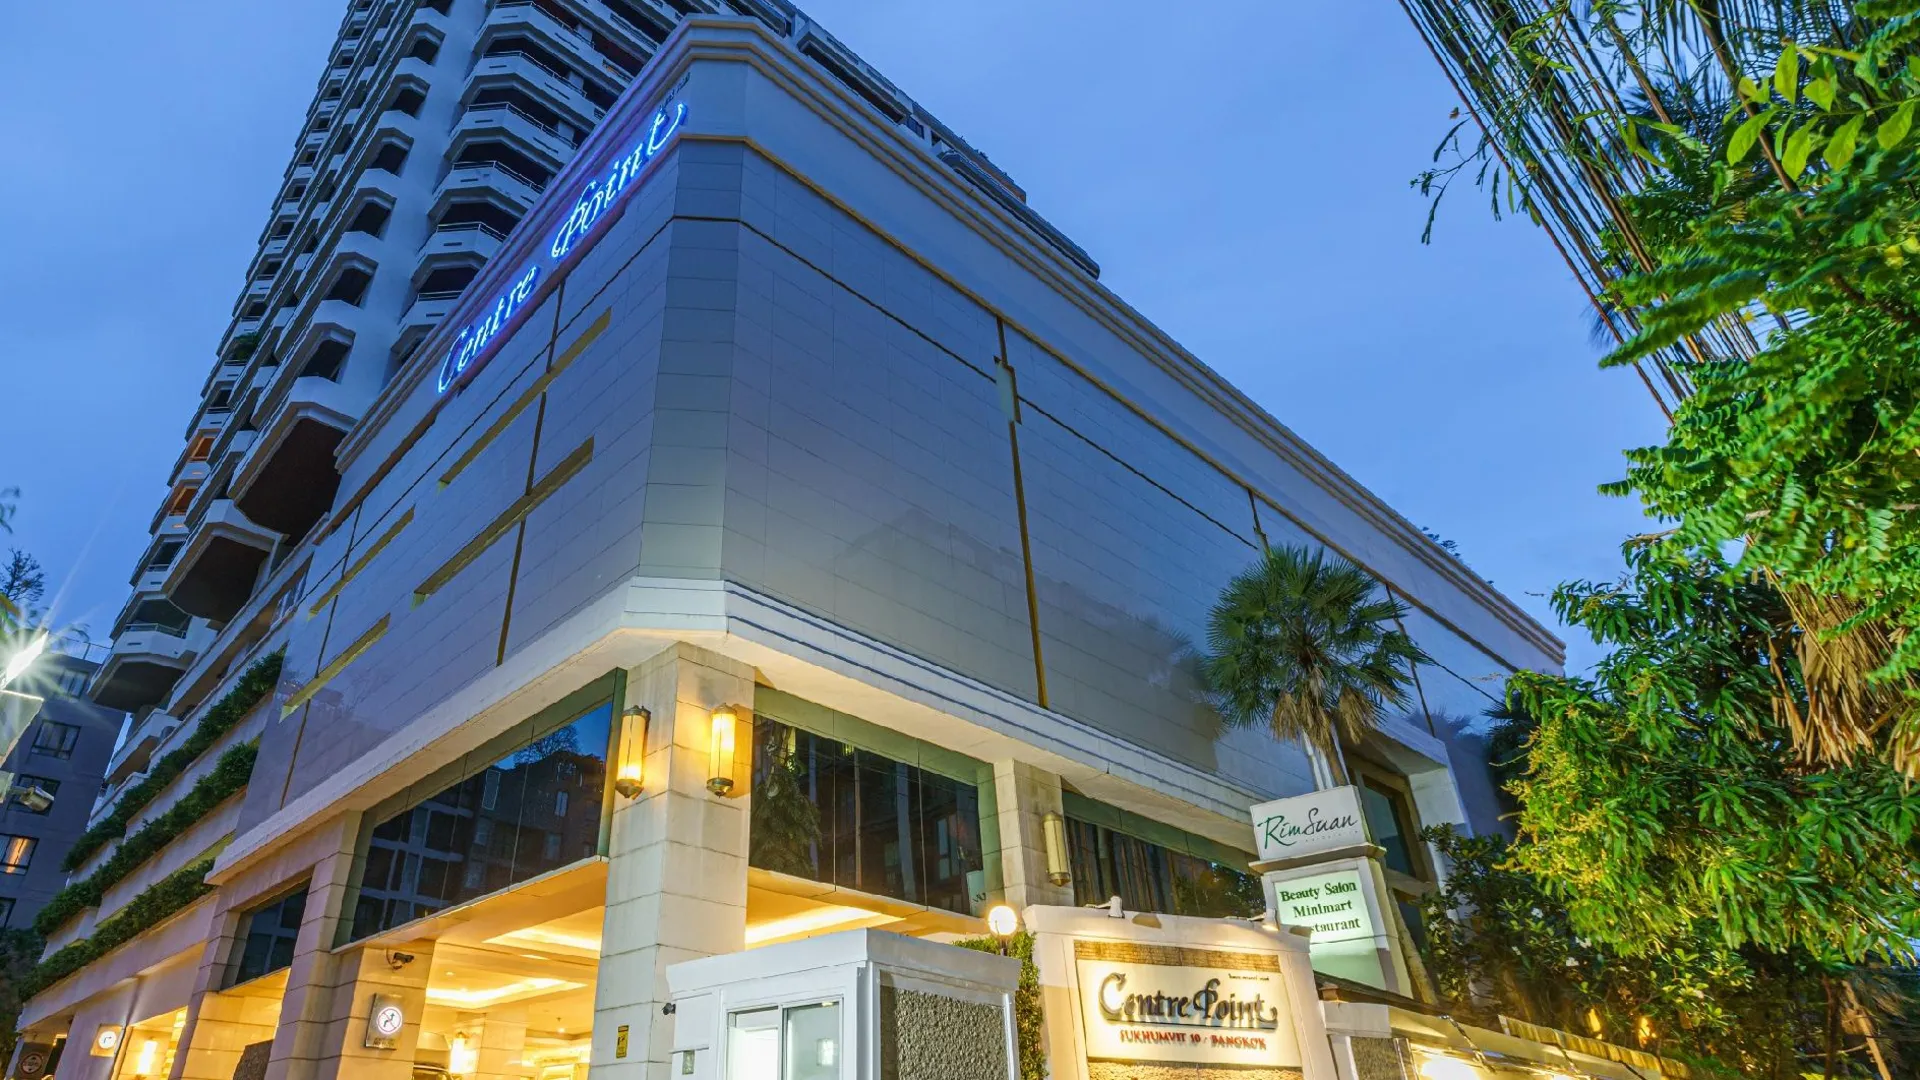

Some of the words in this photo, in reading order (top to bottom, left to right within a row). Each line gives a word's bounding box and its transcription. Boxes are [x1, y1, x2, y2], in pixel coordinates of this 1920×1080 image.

[437, 265, 540, 393] Centre
[551, 102, 689, 258] Point
[1279, 887, 1320, 902] Beauty
[1324, 881, 1357, 896] Salon
[1098, 972, 1191, 1017] Centre
[1193, 978, 1278, 1024] Point
[1120, 1029, 1186, 1045] SUKHUMVIT
[1190, 1033, 1201, 1043] 10
[1211, 1034, 1267, 1050] BANGKOK
